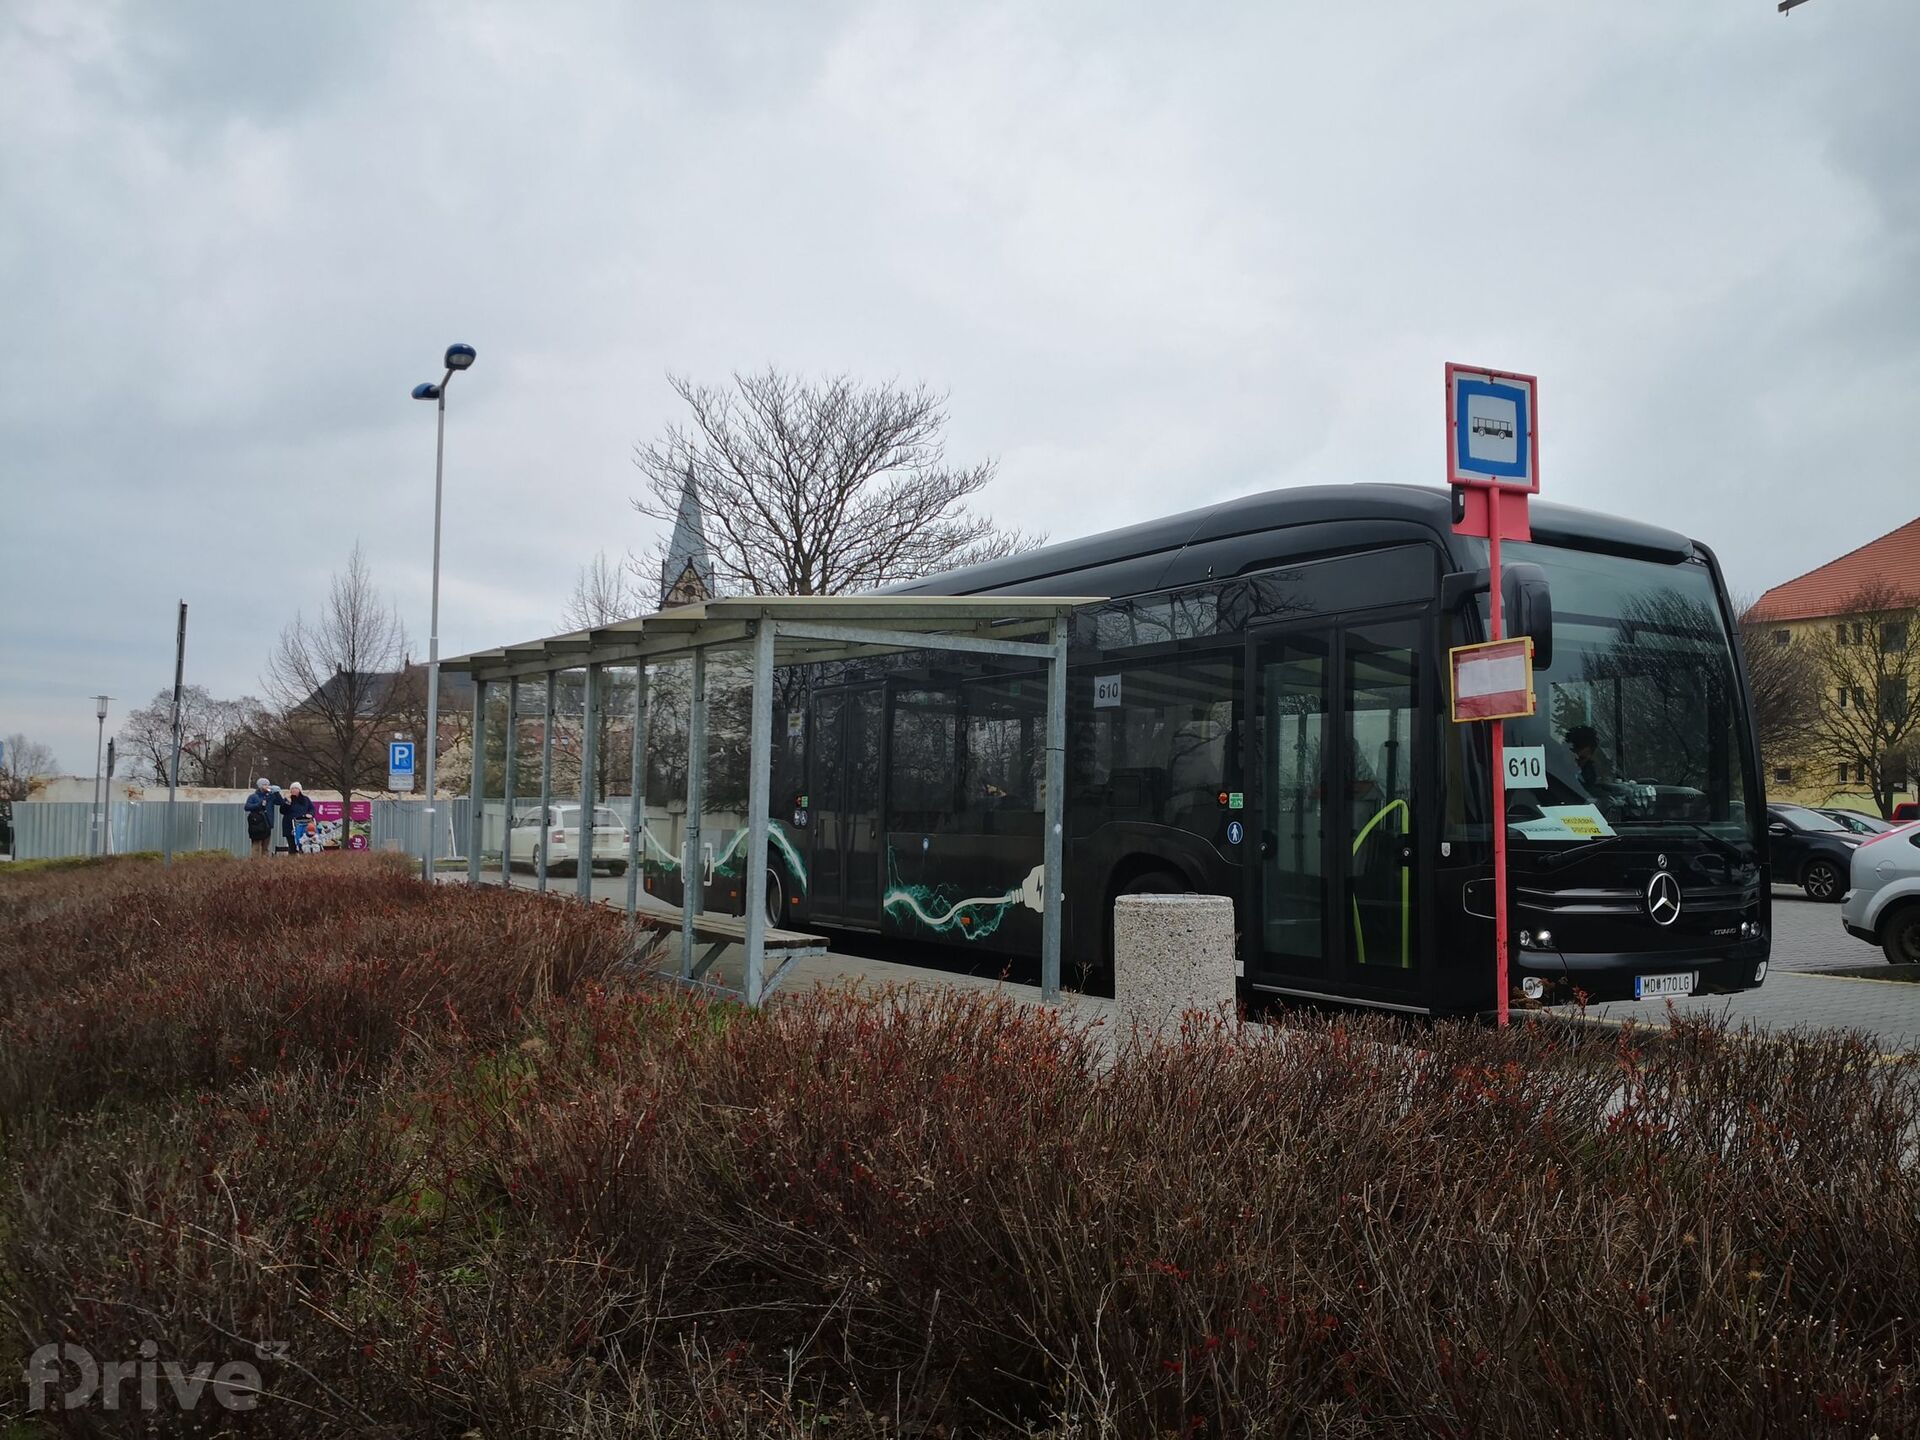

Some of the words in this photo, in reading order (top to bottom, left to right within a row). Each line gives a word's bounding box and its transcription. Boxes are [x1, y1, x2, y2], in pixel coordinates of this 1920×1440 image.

[1099, 683, 1119, 699] 610
[394, 746, 410, 766] P
[1508, 757, 1541, 777] 610
